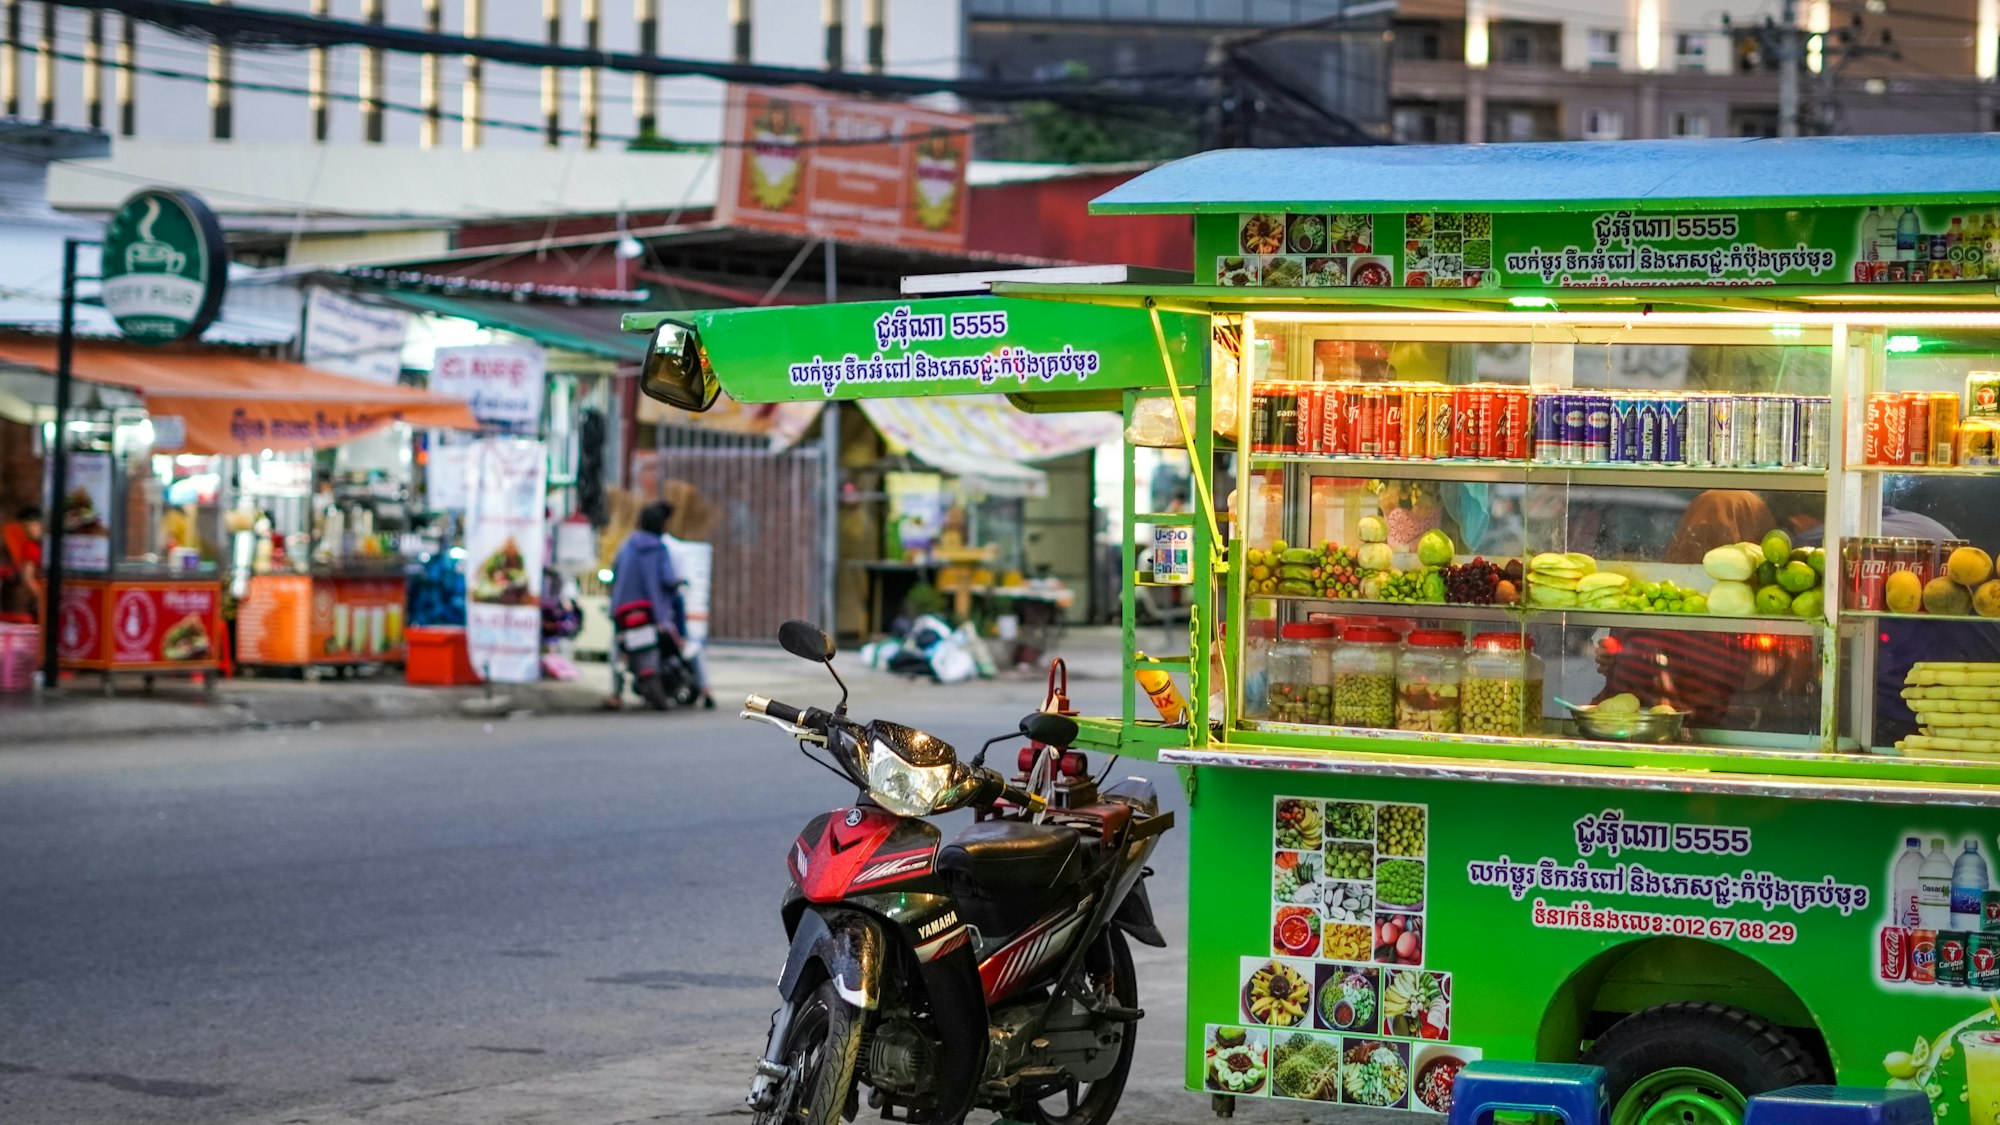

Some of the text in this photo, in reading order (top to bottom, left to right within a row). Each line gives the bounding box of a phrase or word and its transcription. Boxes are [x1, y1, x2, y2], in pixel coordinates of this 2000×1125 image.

[1677, 217, 1736, 237] 5555
[953, 314, 1005, 336] 5555
[1675, 826, 1749, 853] 5555
[918, 910, 957, 939] YAMAHA
[1710, 921, 1734, 937] 67
[1740, 923, 1764, 939] 88
[1769, 925, 1794, 940] 29
